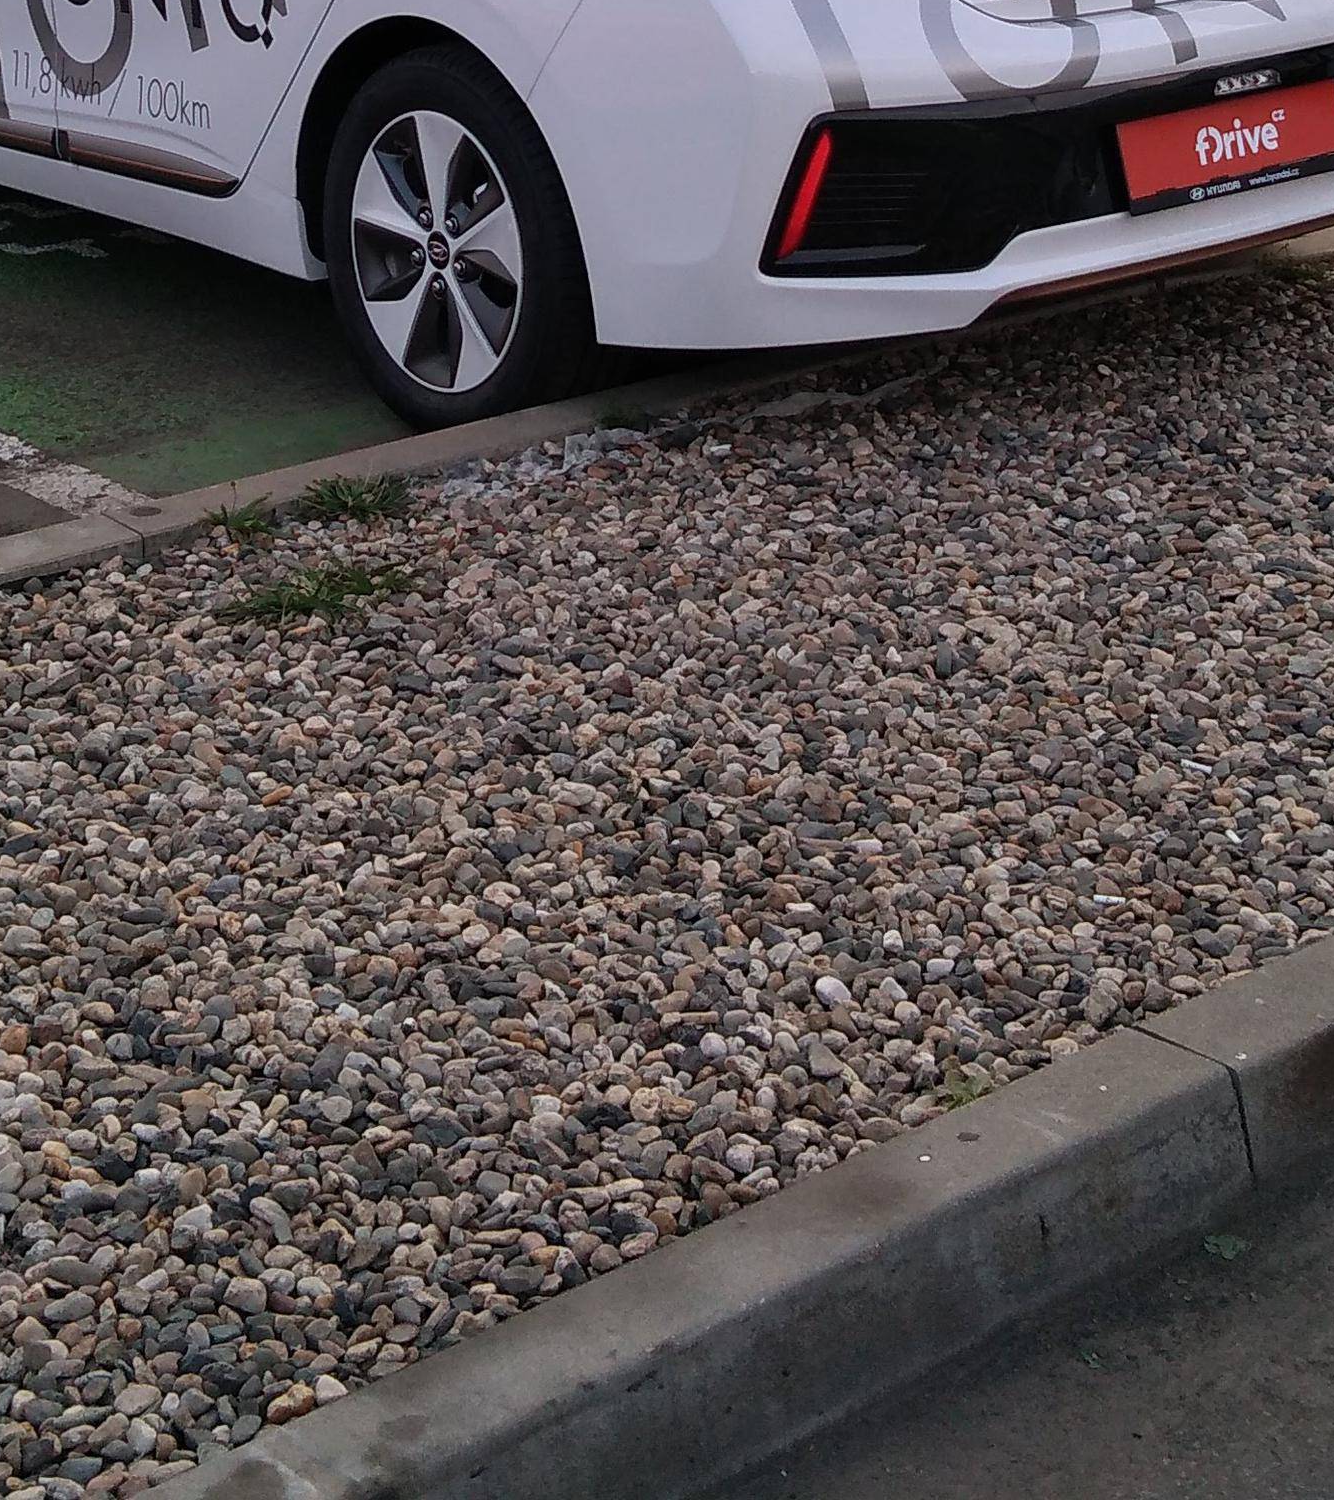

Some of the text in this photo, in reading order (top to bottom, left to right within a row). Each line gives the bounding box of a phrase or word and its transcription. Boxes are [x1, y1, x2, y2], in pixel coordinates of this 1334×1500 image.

[13, 49, 52, 98] 11,8
[60, 55, 101, 106] kwh
[137, 75, 212, 129] 100km
[1206, 180, 1242, 197] HYUNDAI
